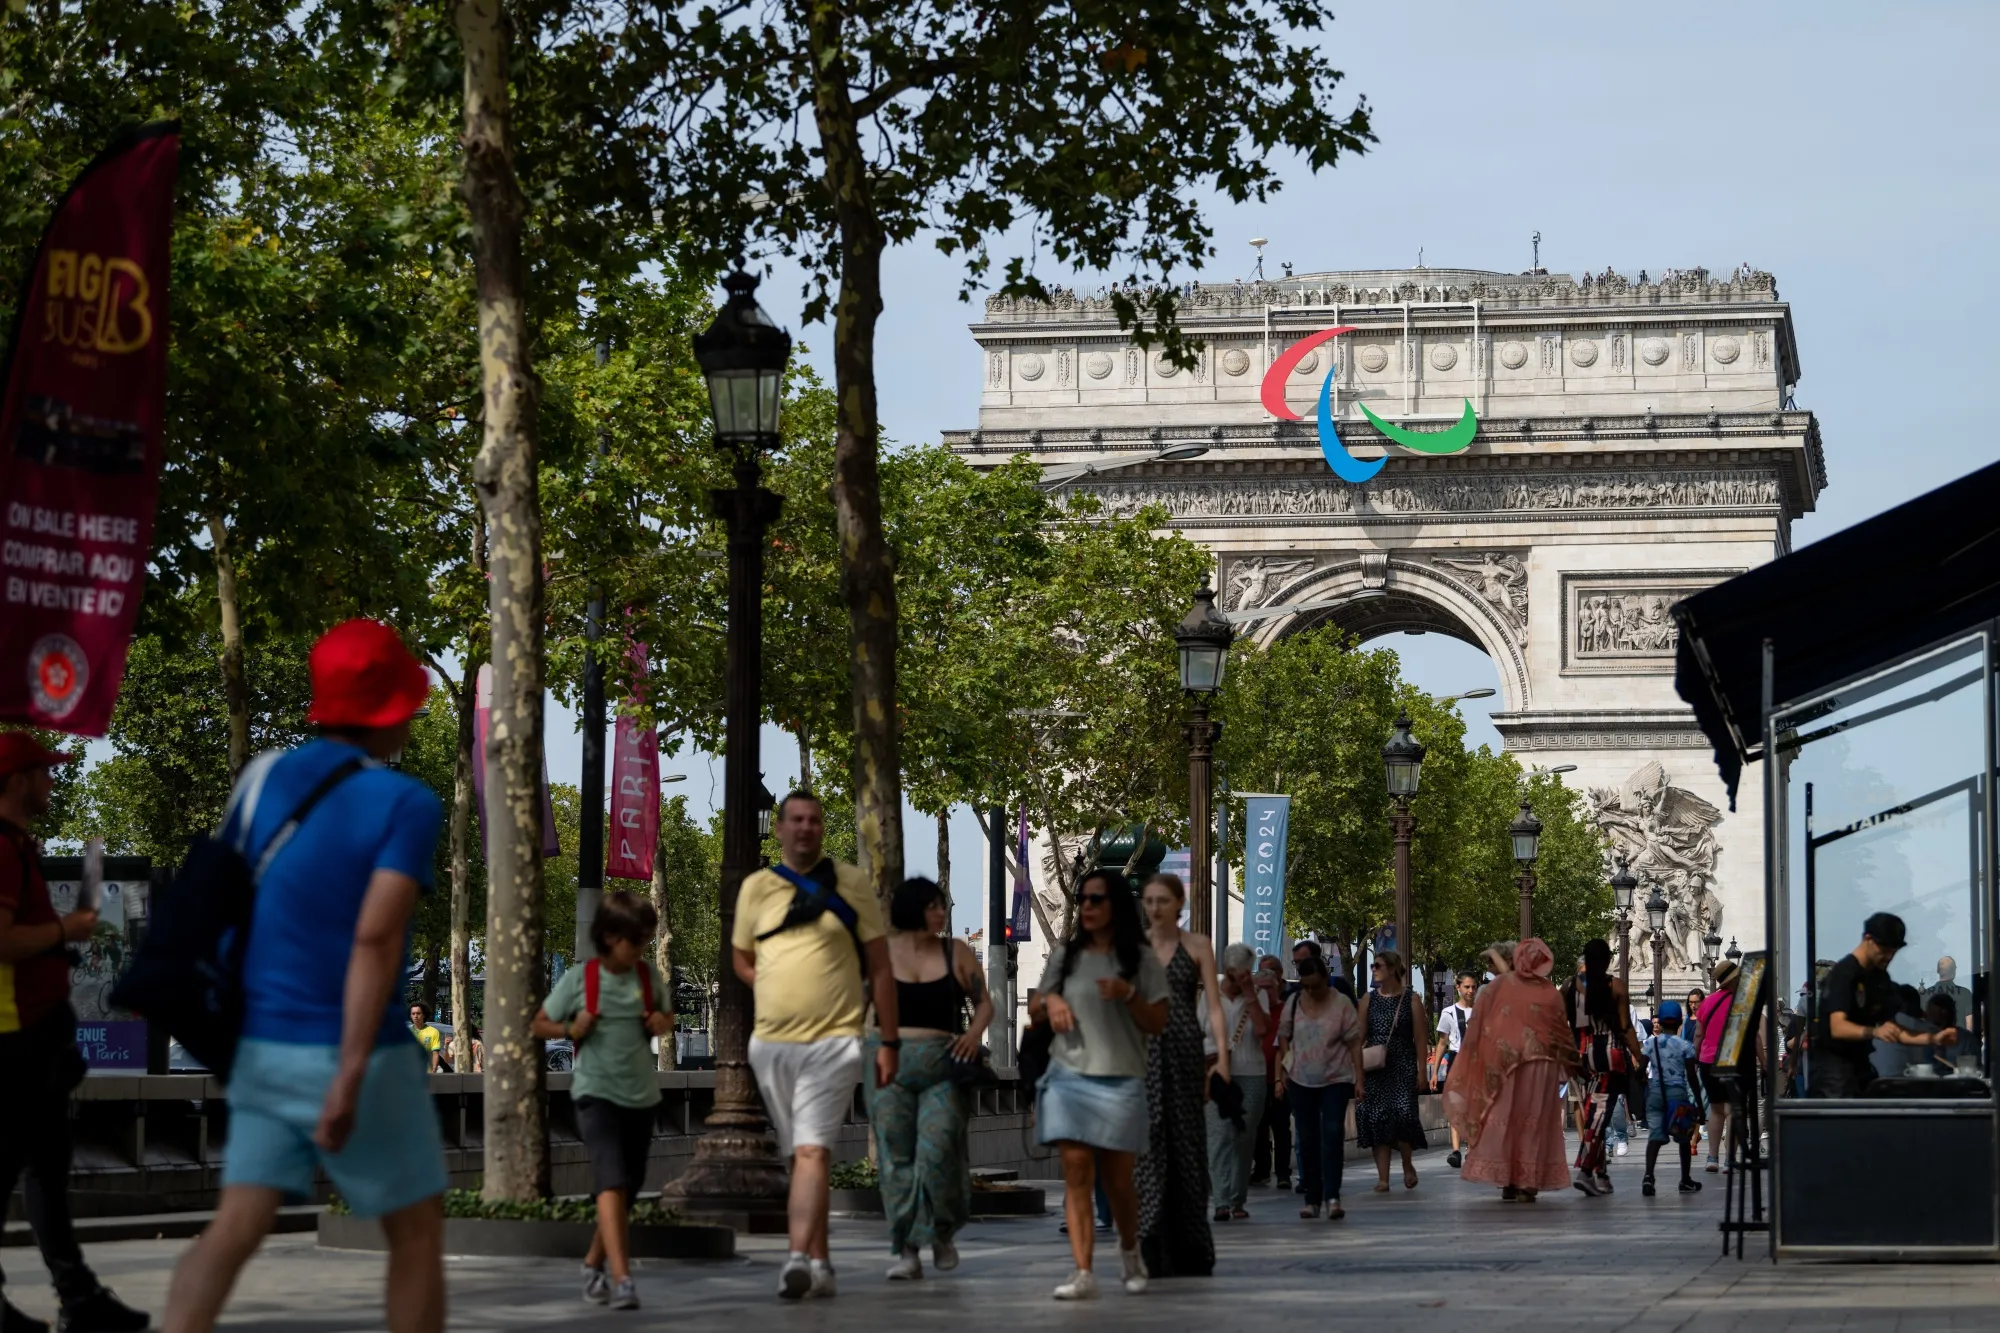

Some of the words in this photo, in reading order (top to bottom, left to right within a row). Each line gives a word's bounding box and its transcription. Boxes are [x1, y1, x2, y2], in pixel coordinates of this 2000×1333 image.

[32, 505, 76, 539] SALE
[78, 513, 140, 545] HERE
[3, 539, 86, 577] COMPRAR
[89, 551, 136, 584] AQU
[29, 580, 98, 615] VENTE
[76, 1027, 107, 1042] ENUE
[90, 1042, 130, 1061] Paris
